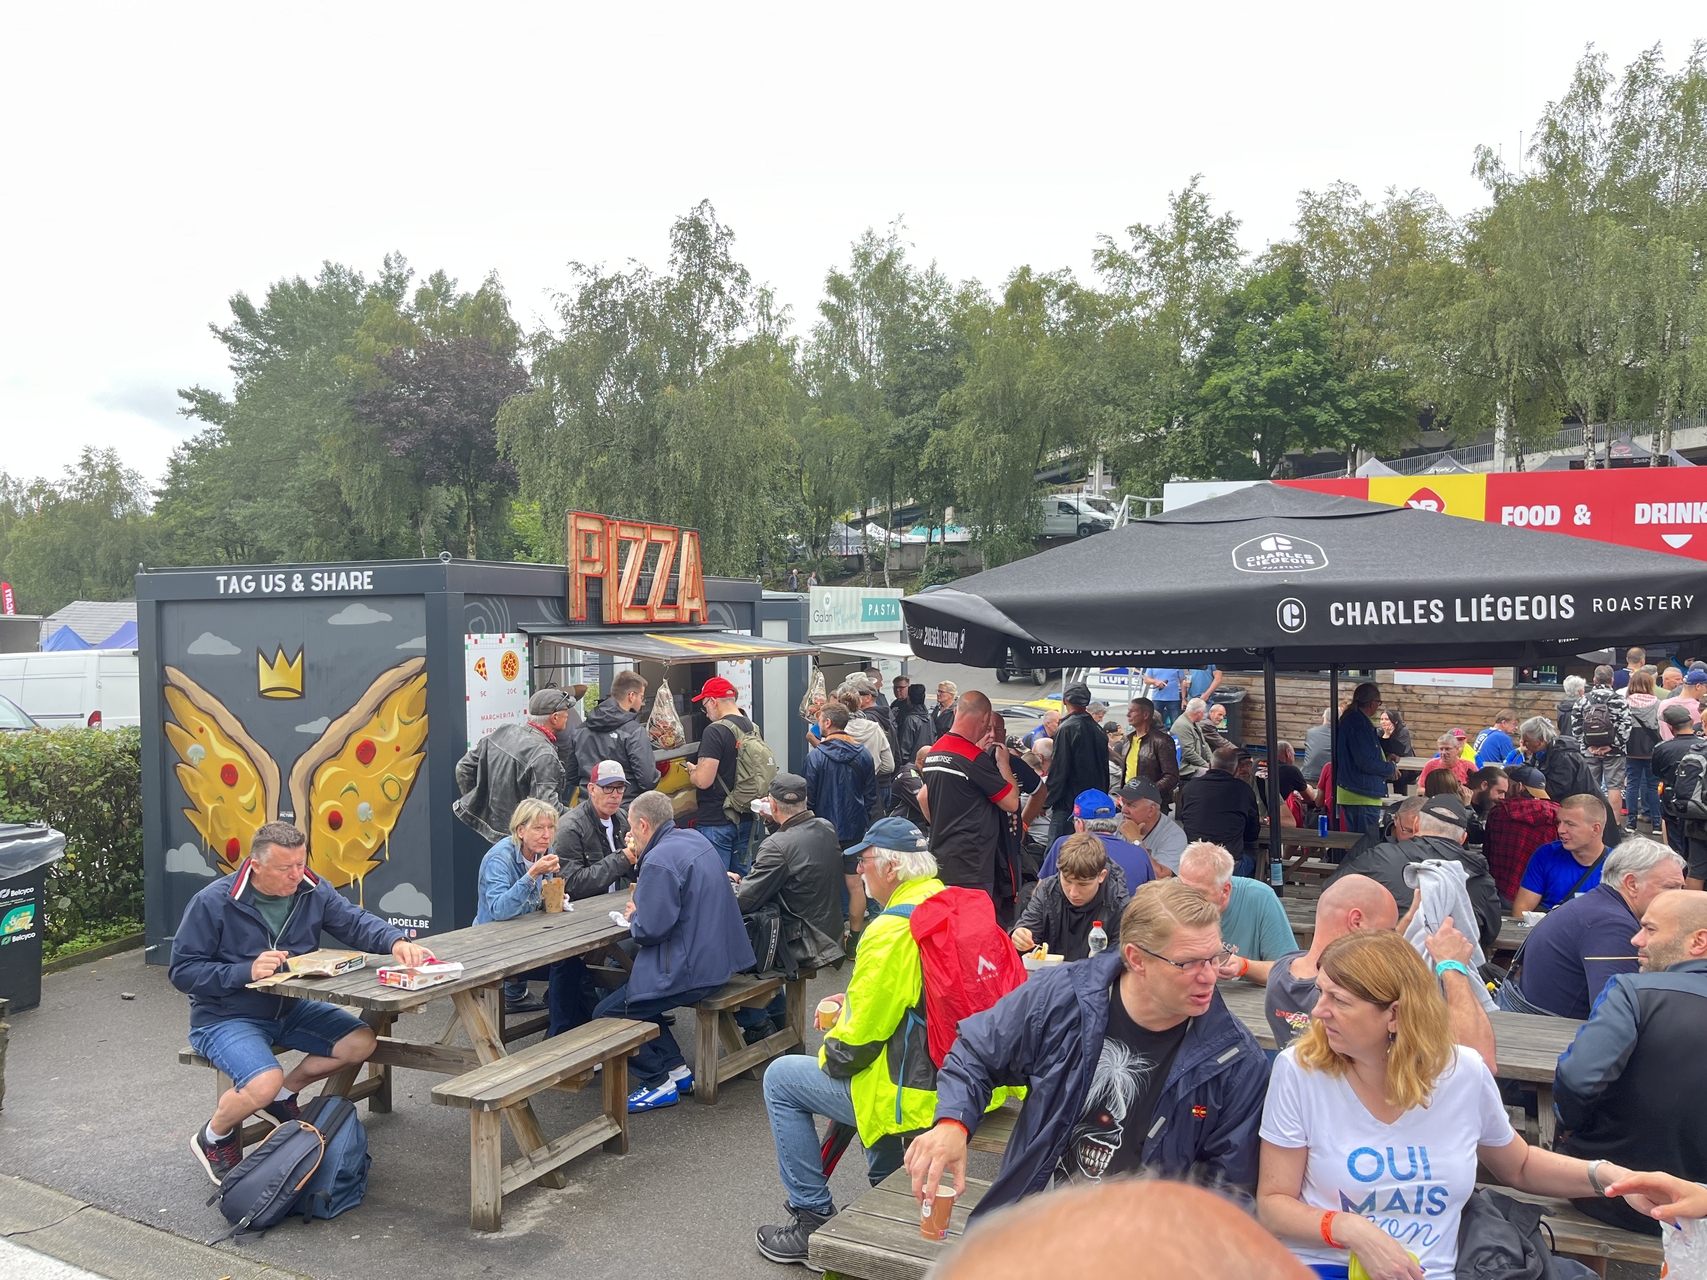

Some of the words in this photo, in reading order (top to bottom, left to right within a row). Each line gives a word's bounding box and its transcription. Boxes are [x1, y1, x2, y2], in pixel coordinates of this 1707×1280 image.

[1501, 505, 1561, 527] FOOD
[1573, 504, 1591, 526] &
[568, 511, 708, 624] PIZZA
[1246, 551, 1313, 562] CHARLES
[216, 575, 256, 594] TAG
[261, 573, 286, 593] US
[291, 573, 305, 592] &
[311, 570, 374, 592] SHARE
[813, 609, 833, 623] Galan
[868, 603, 896, 616] PASTA
[1329, 599, 1445, 626] CHARLES
[1455, 593, 1575, 622] LIÉGEOIS
[1593, 594, 1695, 612] ROASTERY
[507, 687, 517, 695] 20€
[1346, 1145, 1432, 1183] OUI
[1338, 1185, 1449, 1217] MAIS
